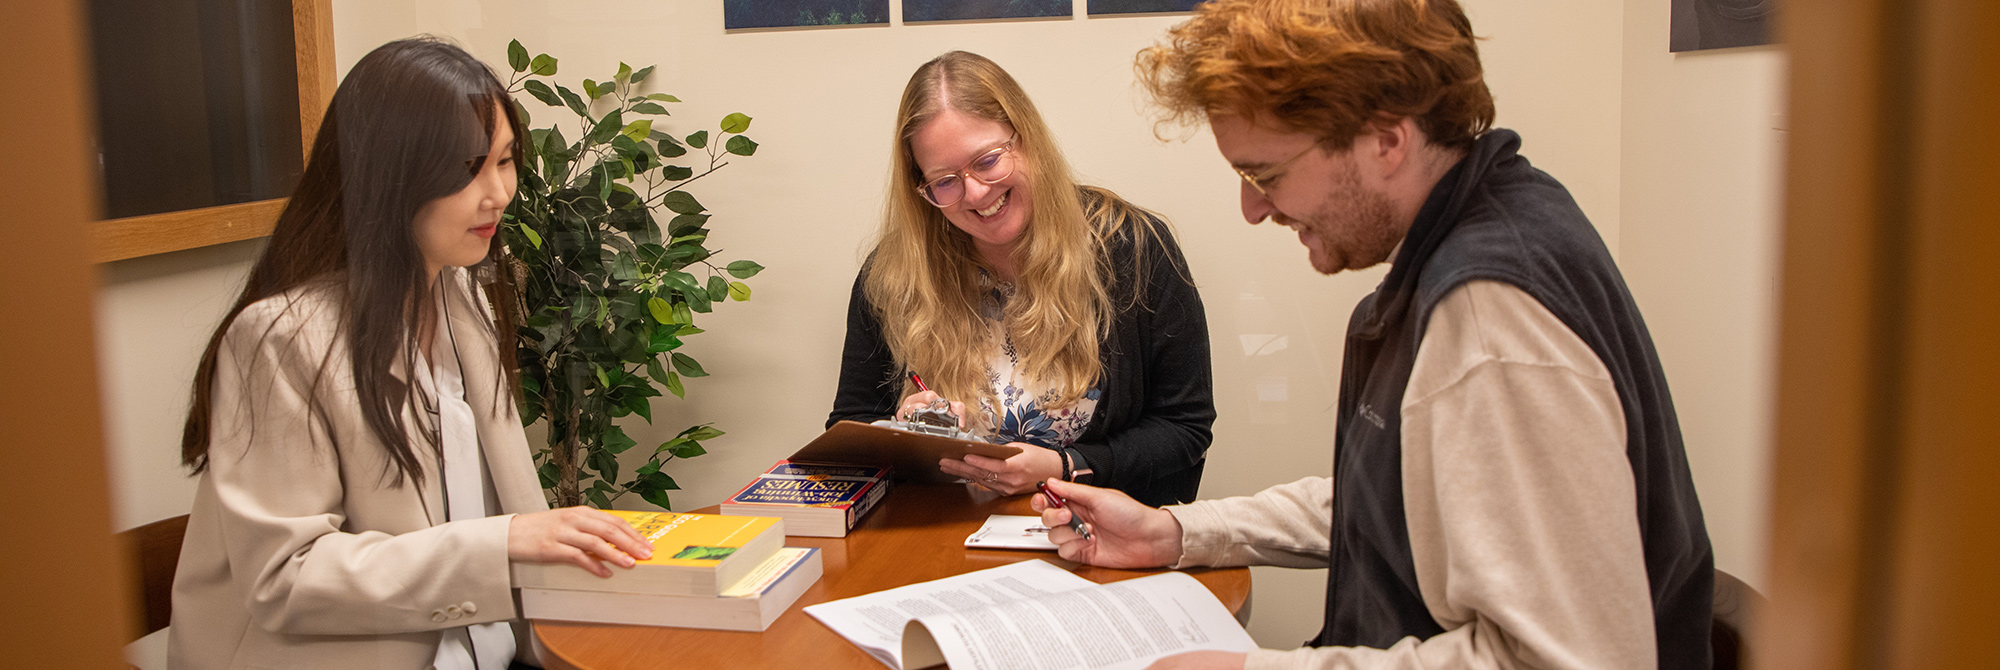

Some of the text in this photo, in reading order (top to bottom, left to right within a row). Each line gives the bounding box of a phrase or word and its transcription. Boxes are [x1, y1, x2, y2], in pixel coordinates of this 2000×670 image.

[761, 479, 857, 490] RESUMES
[753, 489, 849, 498] Job-Winning
[768, 494, 839, 503] Encyclopedia
